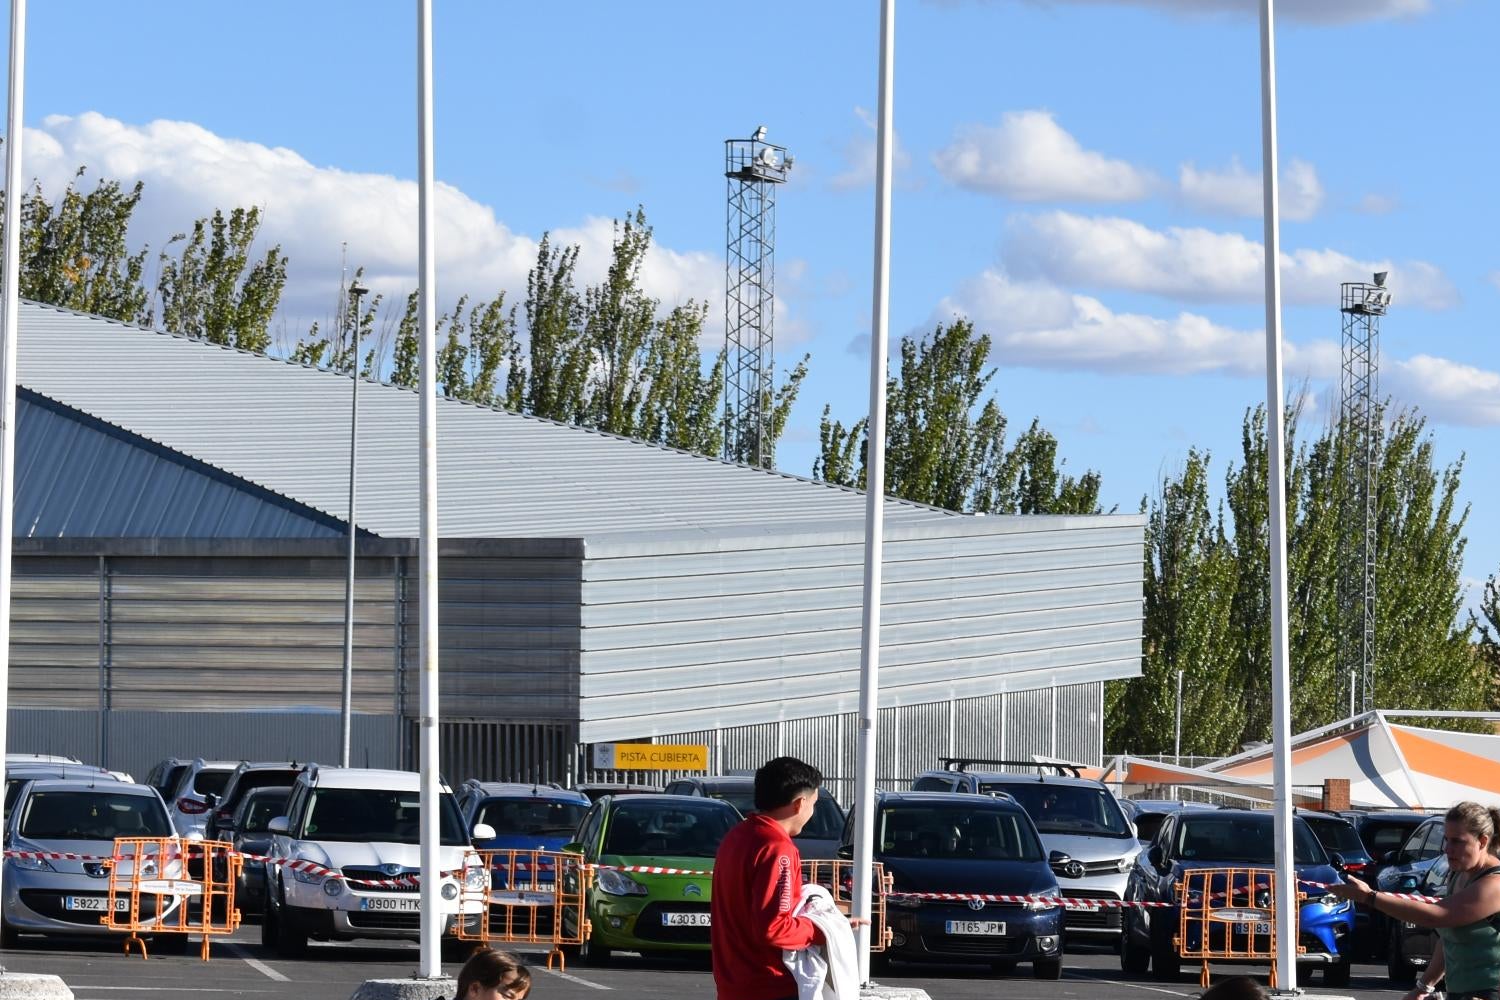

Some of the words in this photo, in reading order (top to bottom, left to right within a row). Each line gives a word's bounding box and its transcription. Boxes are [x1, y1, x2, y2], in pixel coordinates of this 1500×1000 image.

[621, 752, 647, 762] PISTA
[650, 752, 700, 762] CUBIERTA
[778, 855, 791, 912] umbro
[73, 898, 99, 910] 5822
[368, 898, 397, 910] 0900
[670, 914, 696, 925] 4303
[955, 920, 980, 933] 1165
[984, 921, 1004, 934] JPW
